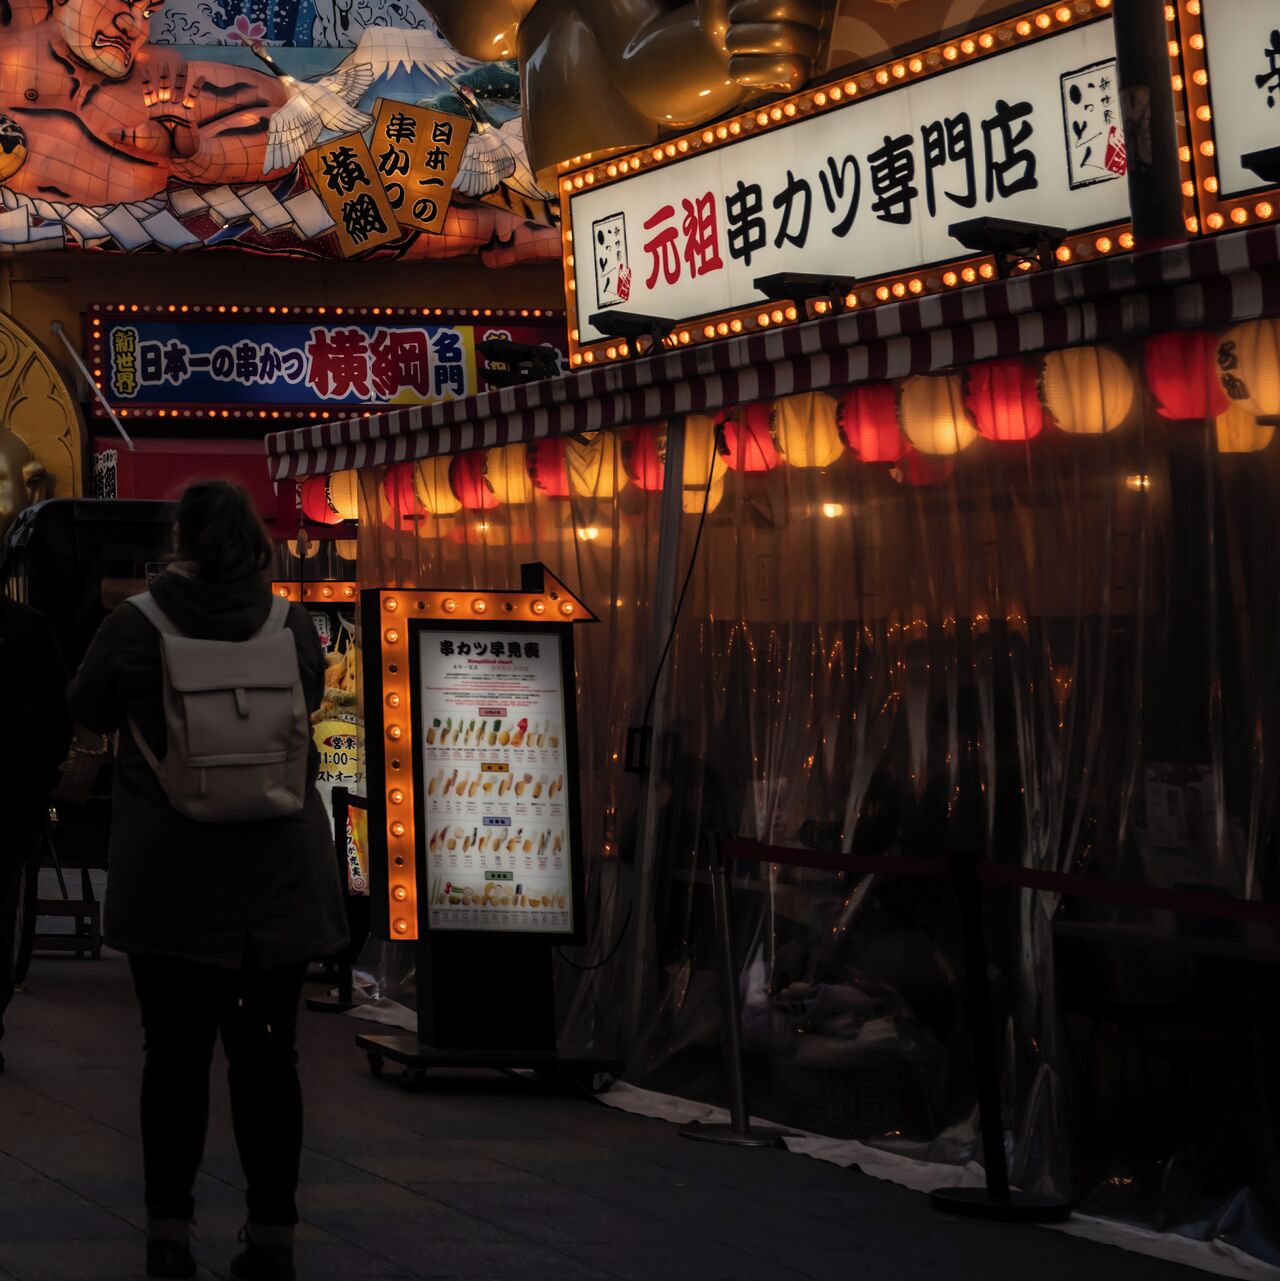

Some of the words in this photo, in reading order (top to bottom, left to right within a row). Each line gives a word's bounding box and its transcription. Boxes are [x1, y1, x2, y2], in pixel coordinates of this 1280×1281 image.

[321, 146, 388, 245] 横綱
[378, 112, 417, 210] 串かつ
[412, 121, 453, 223] 日本一の
[643, 99, 1037, 290] 元祖串カツ専門店
[113, 328, 137, 397] 新世界
[140, 342, 305, 386] 日本一の串かつ
[308, 330, 430, 398] 横綱
[433, 330, 465, 396] 名門
[440, 640, 539, 658] 串カツ早見表
